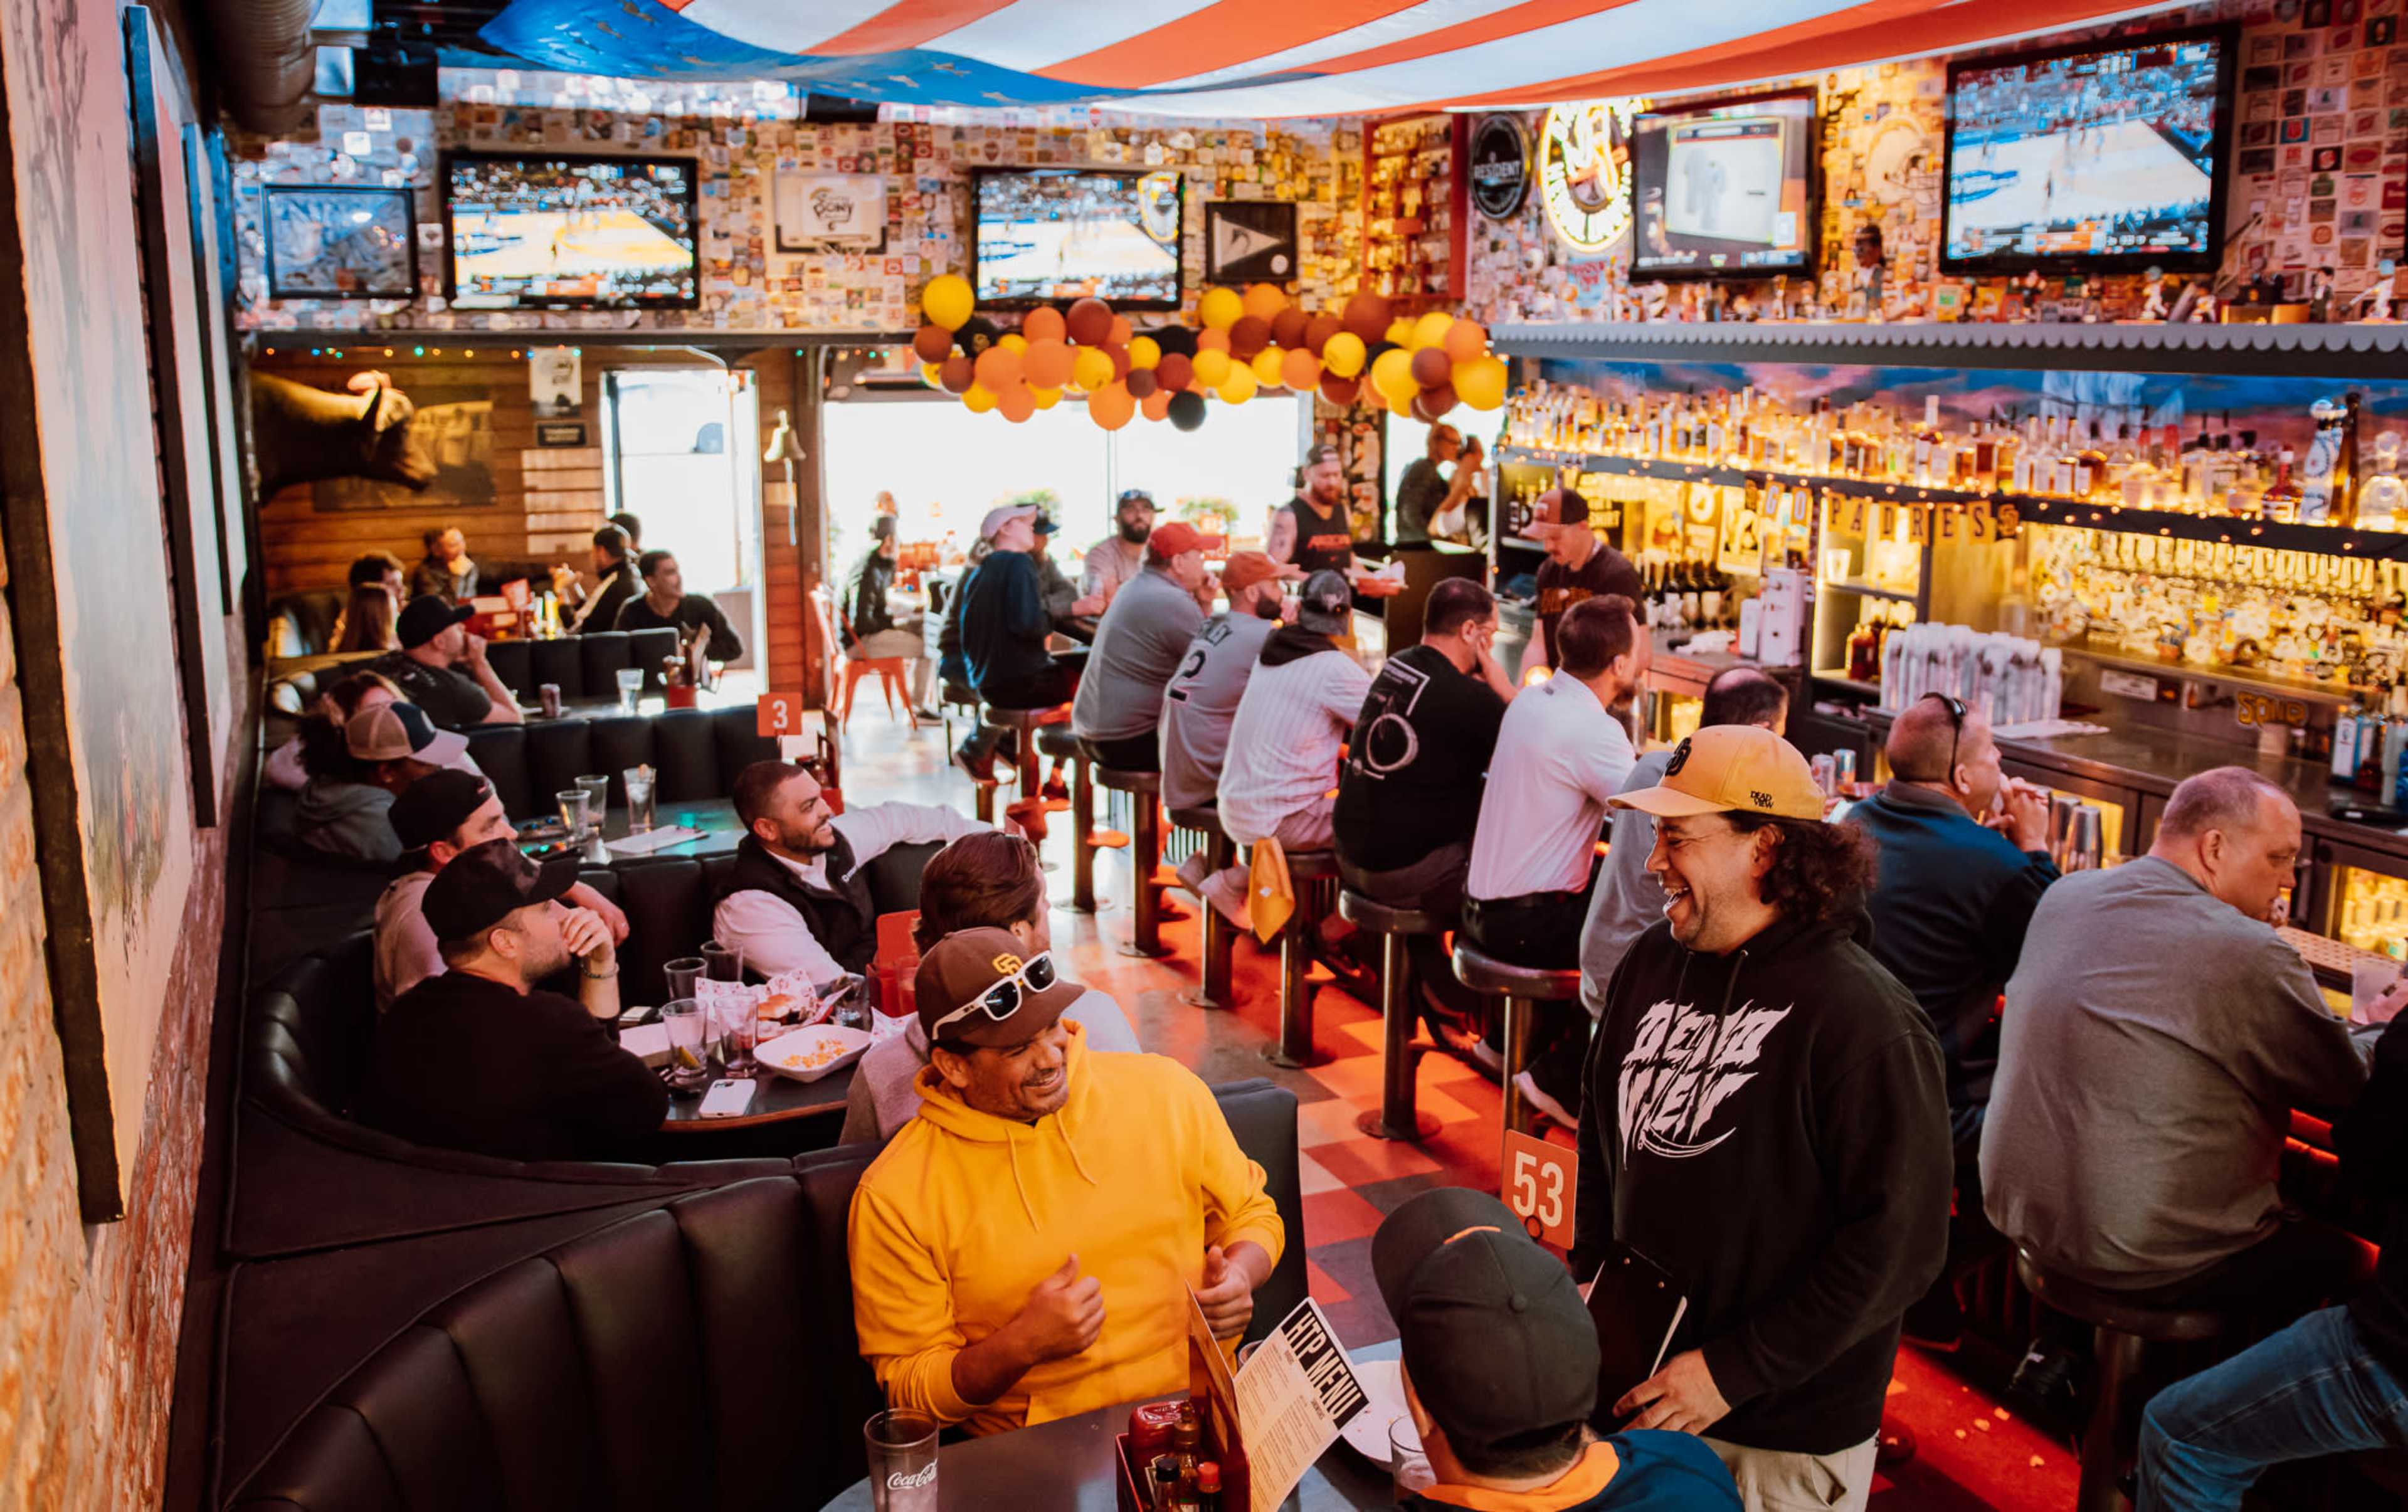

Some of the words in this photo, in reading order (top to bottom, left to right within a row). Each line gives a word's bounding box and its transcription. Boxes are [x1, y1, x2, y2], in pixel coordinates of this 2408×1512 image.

[1474, 161, 1521, 180] RESIDENT
[1766, 484, 1807, 521] GO
[1831, 493, 1985, 538] PADRES
[772, 699, 788, 729] 3
[1513, 1150, 1564, 1228] 53
[1287, 1310, 1328, 1357] HTP
[1307, 1346, 1363, 1417] MENU
